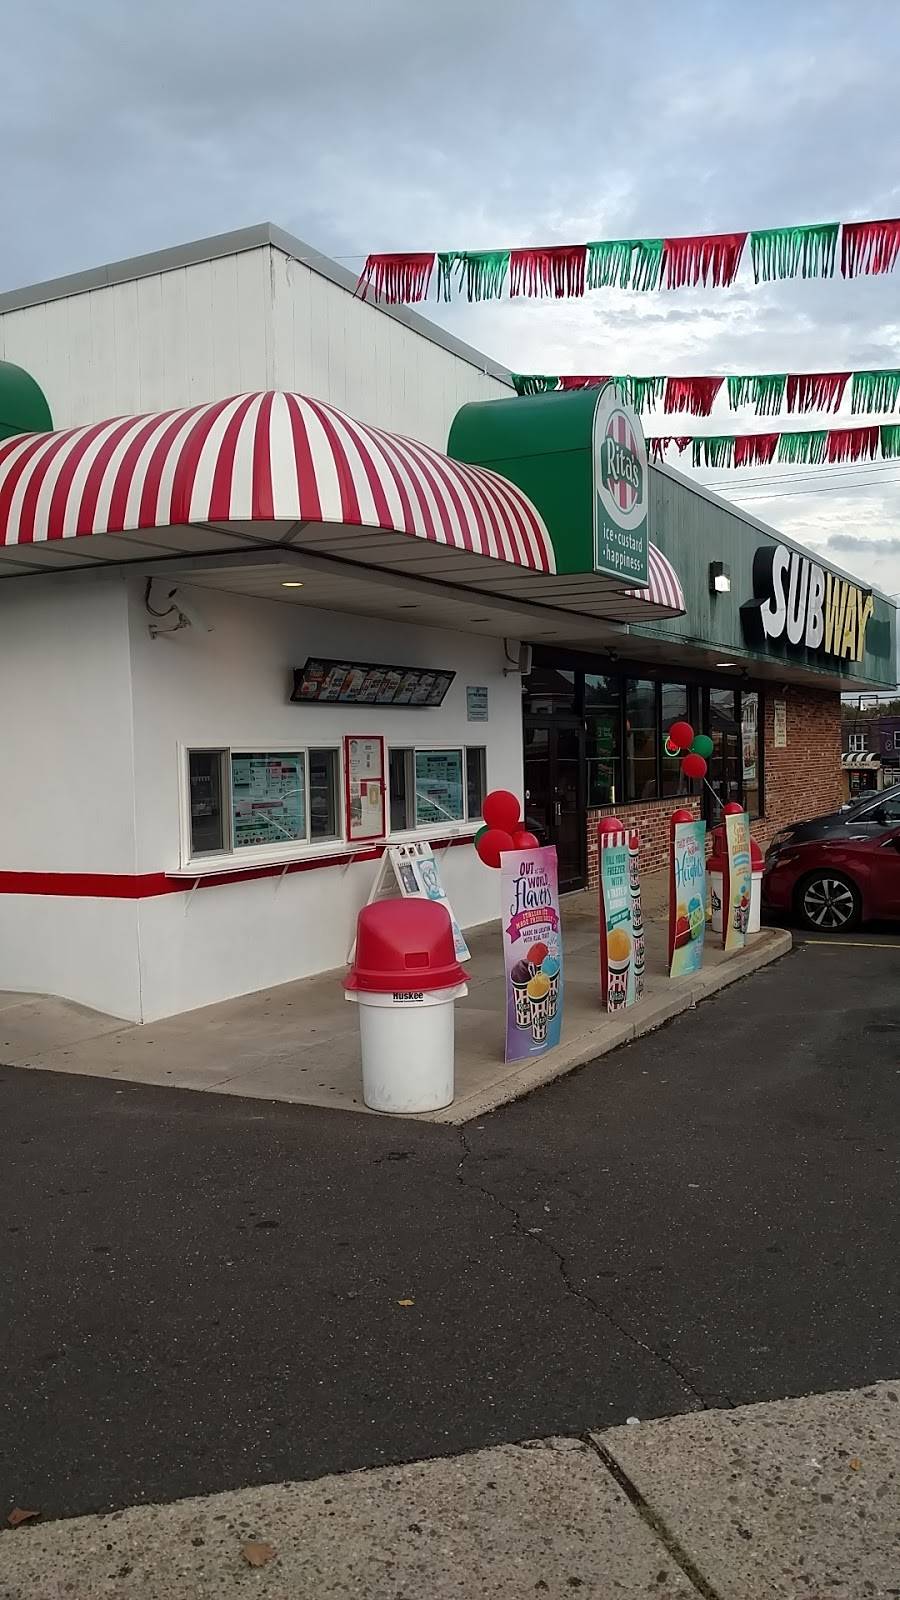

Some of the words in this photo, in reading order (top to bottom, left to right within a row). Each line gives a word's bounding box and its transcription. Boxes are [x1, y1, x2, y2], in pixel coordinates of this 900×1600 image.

[607, 437, 639, 488] Rita's
[760, 544, 875, 662] SUBWAY
[519, 862, 535, 876] OUT
[510, 877, 552, 916] Flavors
[393, 992, 424, 1000] Huskee
